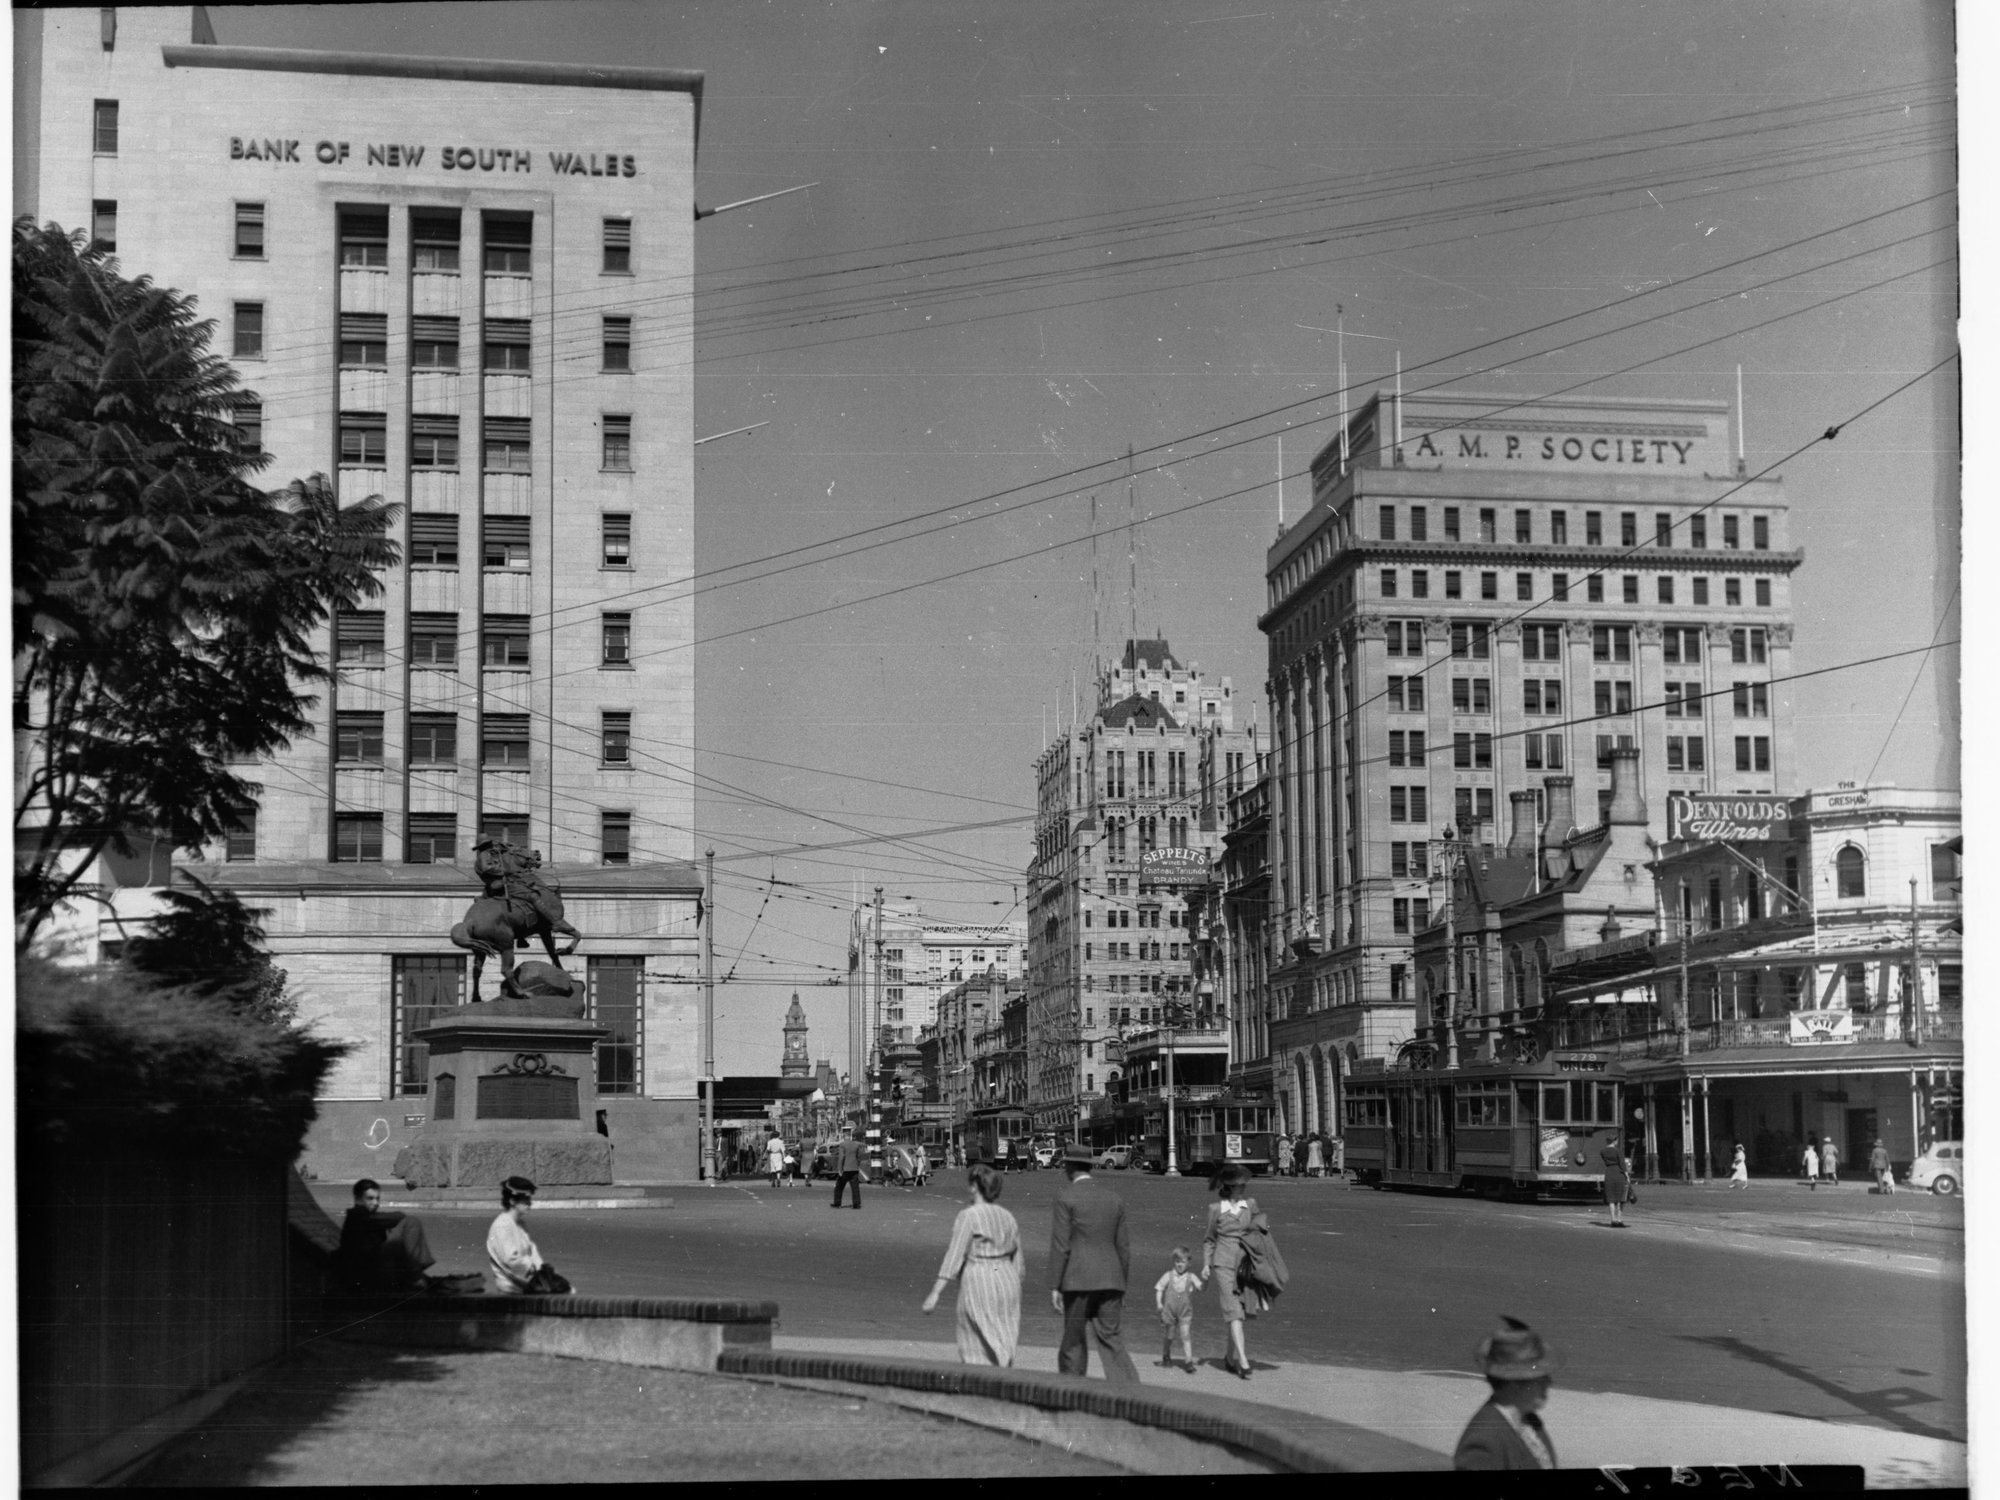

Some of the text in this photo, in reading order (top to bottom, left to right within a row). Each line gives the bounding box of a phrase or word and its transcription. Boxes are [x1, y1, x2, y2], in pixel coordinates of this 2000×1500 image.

[230, 136, 638, 178] BANK OF NEW SOUTH WALES
[1416, 434, 1694, 465] A. M. P. SOCIETY
[1838, 781, 1856, 789] THE
[1671, 797, 1788, 839] PENFOLDS
[1690, 821, 1771, 840] Wines
[1143, 847, 1206, 865] SEPPELTS
[1143, 867, 1174, 875] Chateau
[1806, 1019, 1833, 1033] BALL
[1569, 1053, 1597, 1061] 279
[1562, 1062, 1602, 1071] UNLEY
